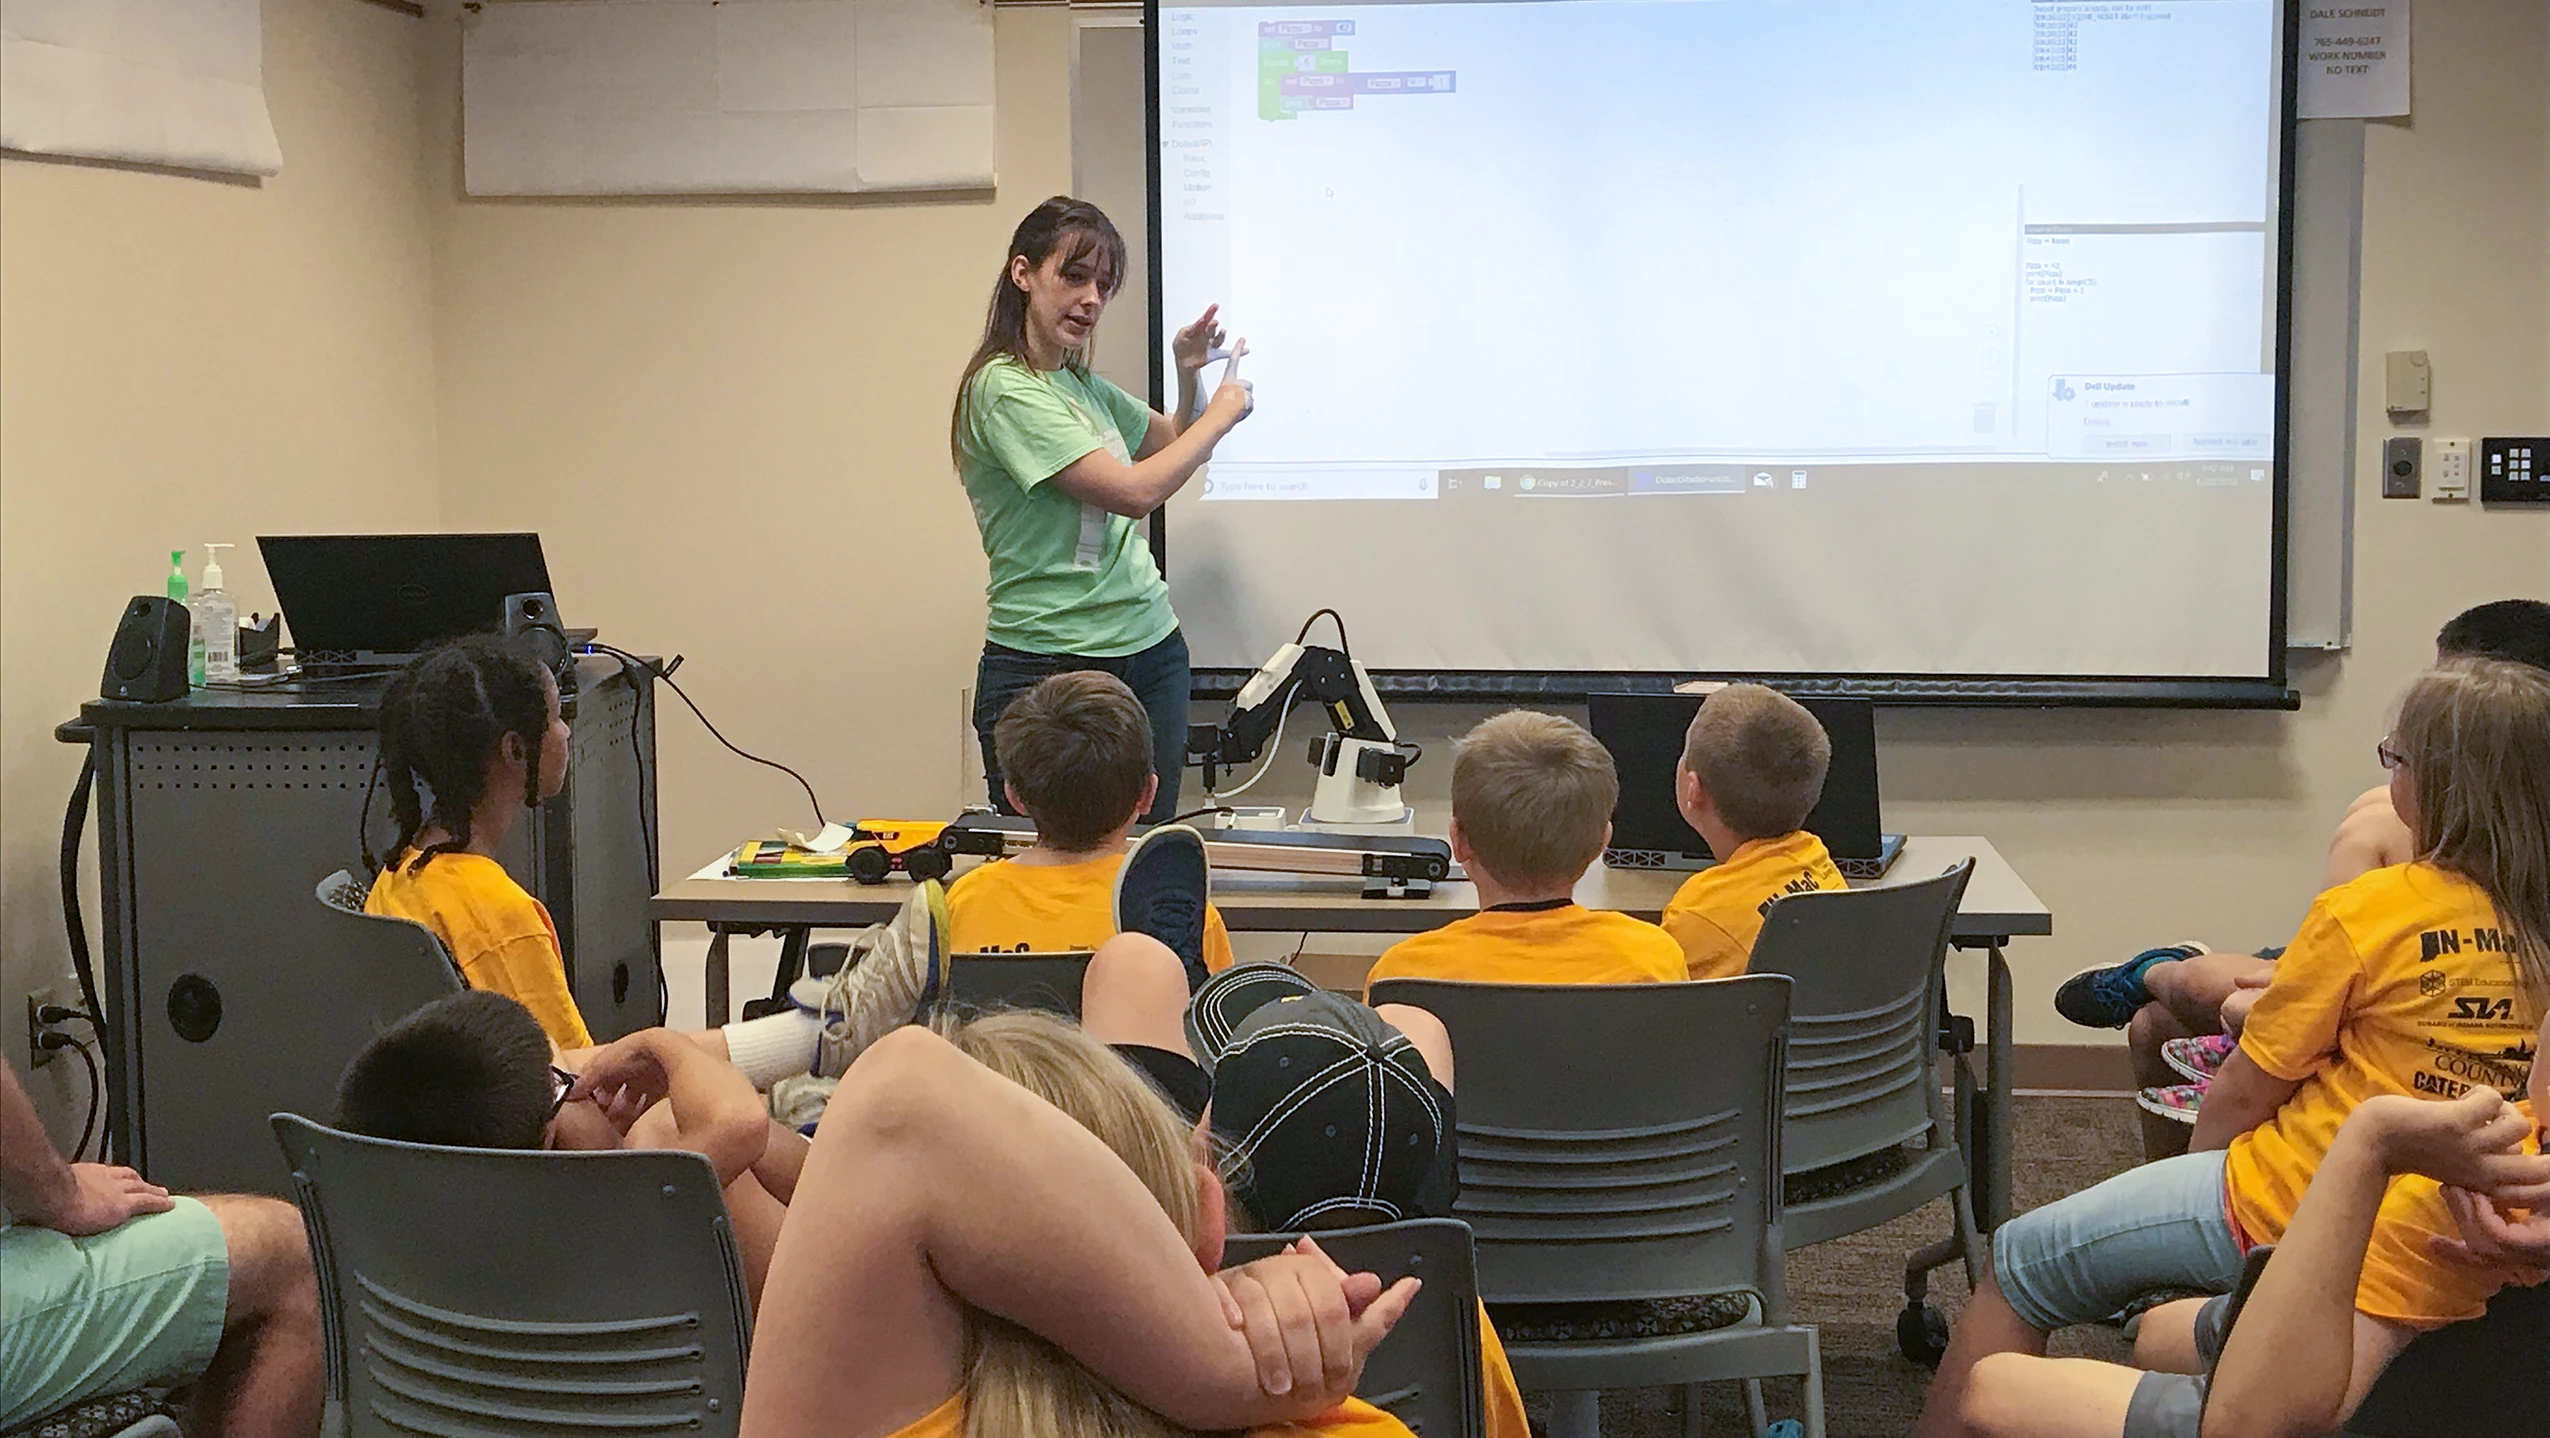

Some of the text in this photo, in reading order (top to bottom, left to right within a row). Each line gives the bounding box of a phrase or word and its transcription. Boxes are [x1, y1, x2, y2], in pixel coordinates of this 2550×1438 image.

[2310, 9, 2335, 19] DALE
[2308, 51, 2387, 61] WORK NUMBER
[2326, 65, 2369, 75] NO TEXT
[2084, 382, 2135, 392] Dell Update
[2091, 399, 2120, 409] update
[2130, 399, 2153, 409] ready
[2154, 399, 2163, 407] to
[1221, 481, 1308, 492] Type here to search
[1537, 479, 1558, 489] Copy
[1559, 478, 1569, 487] of
[2449, 977, 2473, 987] STEM
